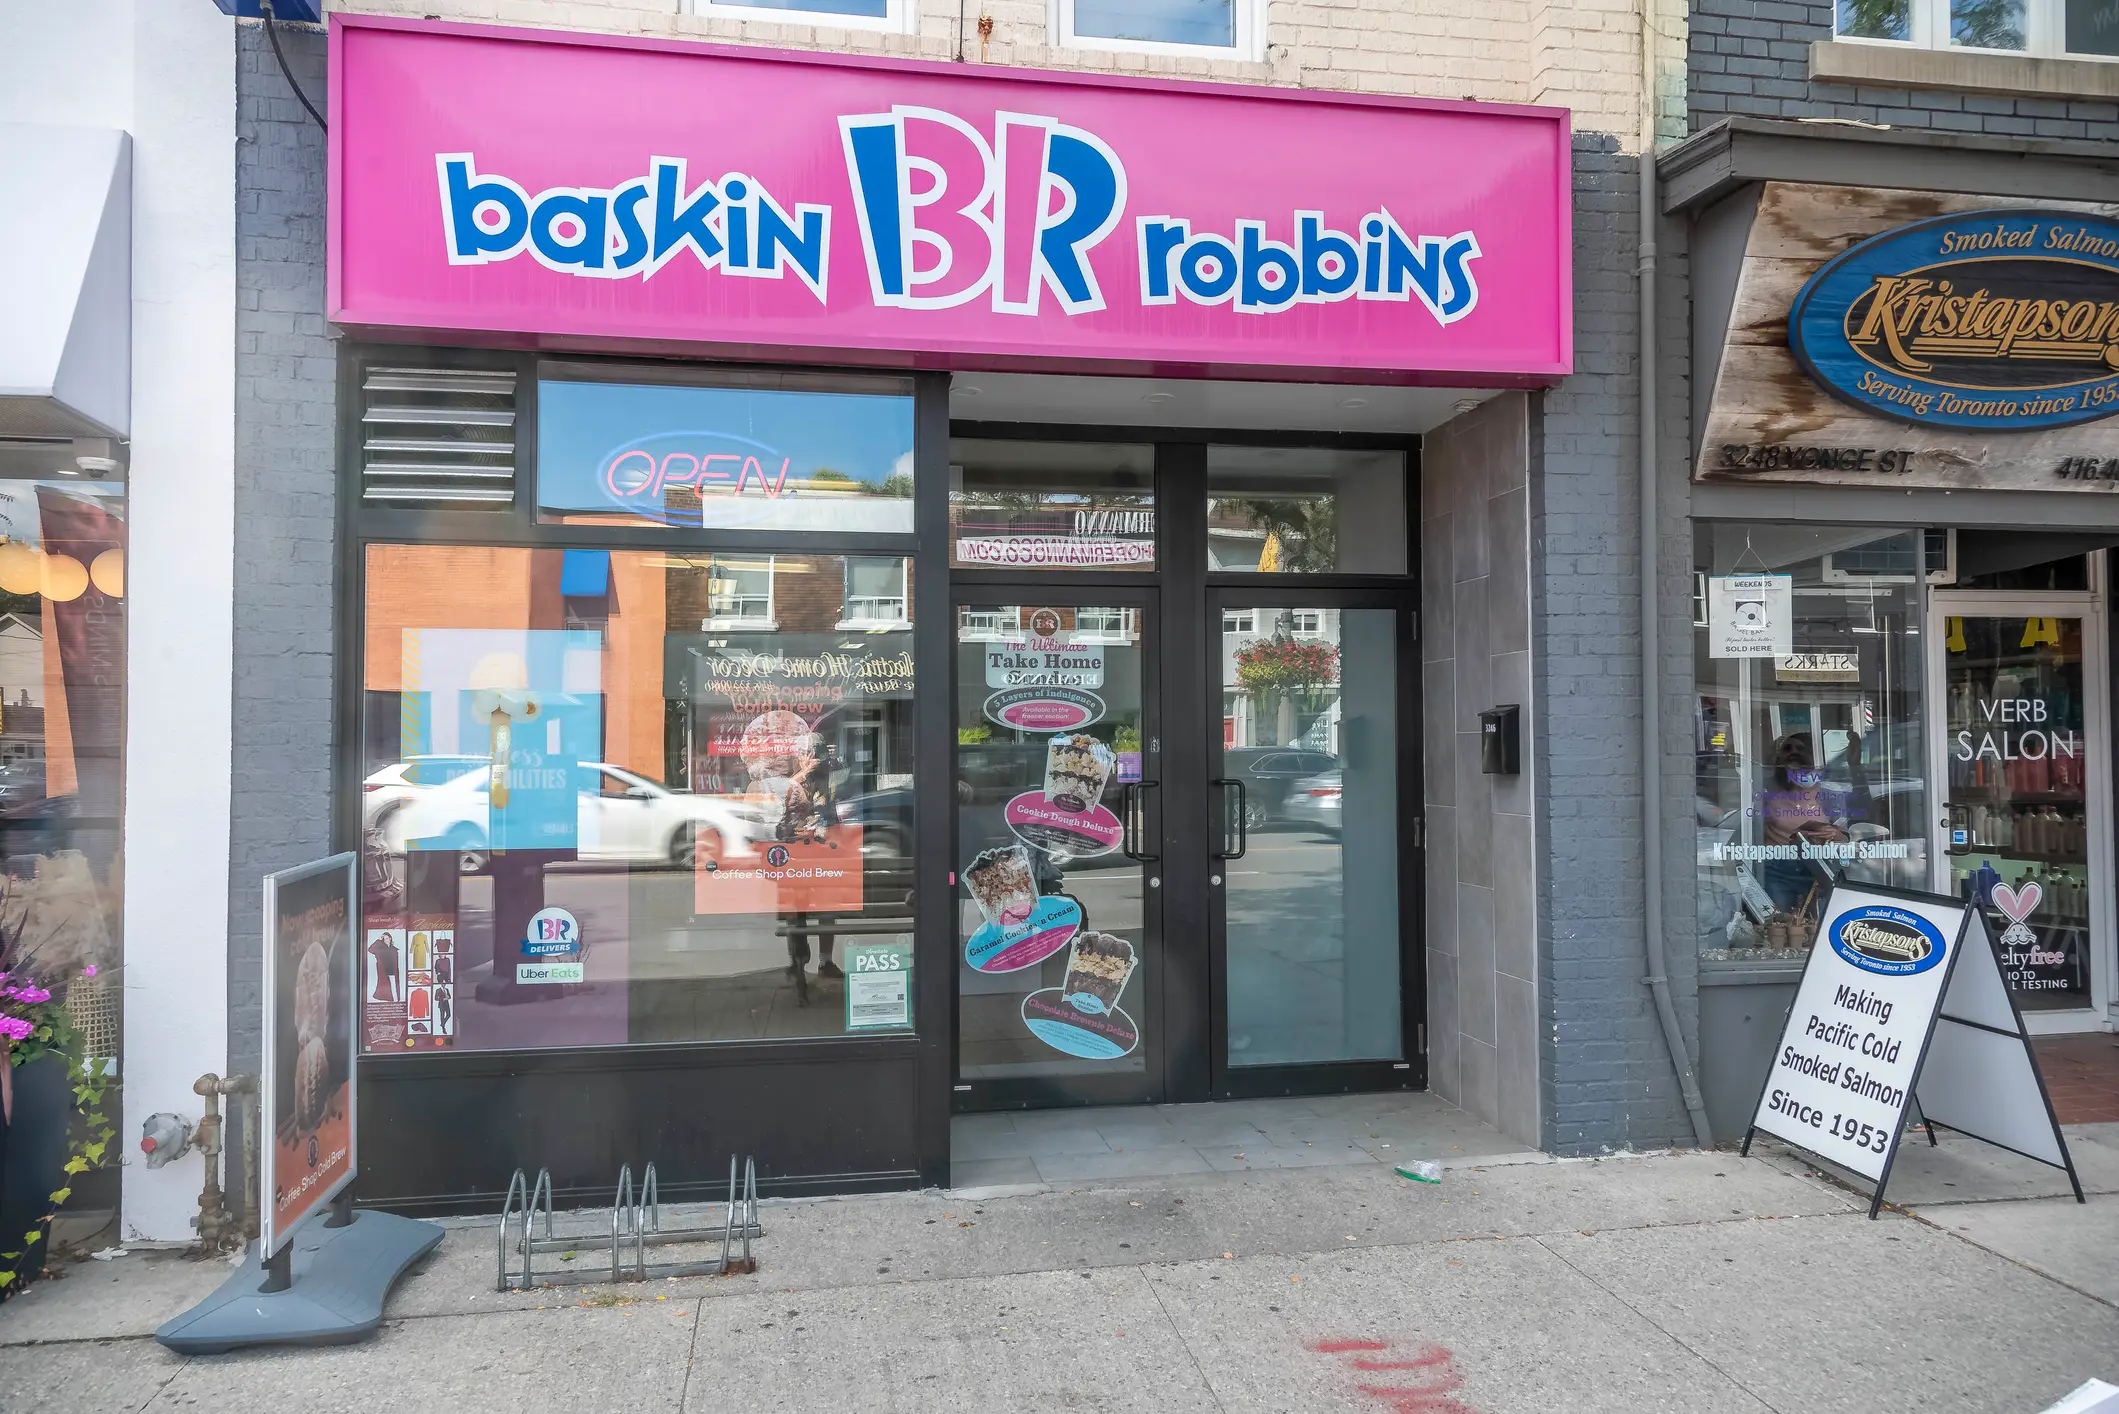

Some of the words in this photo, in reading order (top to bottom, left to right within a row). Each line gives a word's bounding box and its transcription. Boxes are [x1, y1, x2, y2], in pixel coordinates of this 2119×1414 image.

[435, 152, 831, 306] baskin
[837, 104, 1127, 316] BR
[1136, 205, 1483, 328] robbins
[1939, 224, 2038, 255] Smoked
[2043, 226, 2119, 258] Salmo
[1849, 275, 2119, 372] Kristapson
[1857, 371, 1934, 414] Serving
[1936, 391, 2017, 416] Toronto
[2020, 395, 2075, 416] since
[2080, 383, 2119, 408] 195
[1719, 444, 1780, 468] 3248
[1783, 446, 1874, 471] YONGE
[607, 449, 790, 500] OPEN
[1005, 639, 1026, 651] The
[1030, 638, 1087, 652] Ultimate
[989, 653, 1038, 668] Take
[1044, 653, 1101, 669] Home
[733, 698, 773, 714] cold
[777, 697, 824, 714] brew
[993, 700, 1001, 708] 5
[1002, 690, 1033, 703] Layers
[1035, 688, 1043, 697] of
[1046, 688, 1096, 709] Indulgence
[1980, 698, 2048, 723] VERB
[1956, 729, 2074, 762] SALON
[1786, 769, 1825, 783] NEW
[1753, 790, 1811, 801] ORGANIC
[1016, 804, 1049, 819] Cookie
[1050, 811, 1081, 828] Dough
[1082, 820, 1115, 836] Deluxe
[1745, 807, 1771, 818] Cold
[1776, 807, 1821, 818] Smoked
[1713, 842, 1799, 862] Kristapsons
[1801, 841, 1856, 860] Smoked
[1858, 841, 1908, 859] Salmon
[712, 869, 753, 880] Coffee
[755, 868, 784, 881] Shop
[786, 868, 813, 879] Cold
[815, 866, 844, 877] Brew
[413, 917, 454, 930] Fashion
[537, 918, 571, 941] BR
[1865, 909, 1892, 918] Smoked
[1892, 911, 1917, 926] Salmon
[969, 935, 1005, 957] Caramel
[1005, 922, 1038, 940] Cookies
[1047, 905, 1075, 921] Cream
[530, 943, 571, 954] DELIVERS
[1841, 946, 1860, 964] Serving
[1860, 958, 1883, 970] Toronto
[1883, 963, 1900, 972] since
[1900, 963, 1916, 972] 1953
[520, 968, 549, 979] Uber
[551, 967, 580, 979] Eats
[856, 953, 900, 972] PASS
[2021, 979, 2068, 990] TESTING
[2022, 970, 2036, 980] TO
[1833, 984, 1893, 1026] Making
[1028, 998, 1069, 1018] Chocolate
[1070, 1011, 1105, 1031] Brownie
[1106, 1024, 1135, 1040] Deluxe
[1805, 1014, 1860, 1051] Pacific
[1861, 1032, 1902, 1065] Cold
[1780, 1045, 1842, 1085] Smoked
[1840, 1066, 1904, 1109] Salmon
[1768, 1089, 1823, 1129] Since
[1829, 1113, 1890, 1155] 1953
[279, 1186, 301, 1212] Coffee
[301, 1171, 318, 1192] Shop
[317, 1156, 331, 1177] Cold
[331, 1146, 347, 1166] Brew
